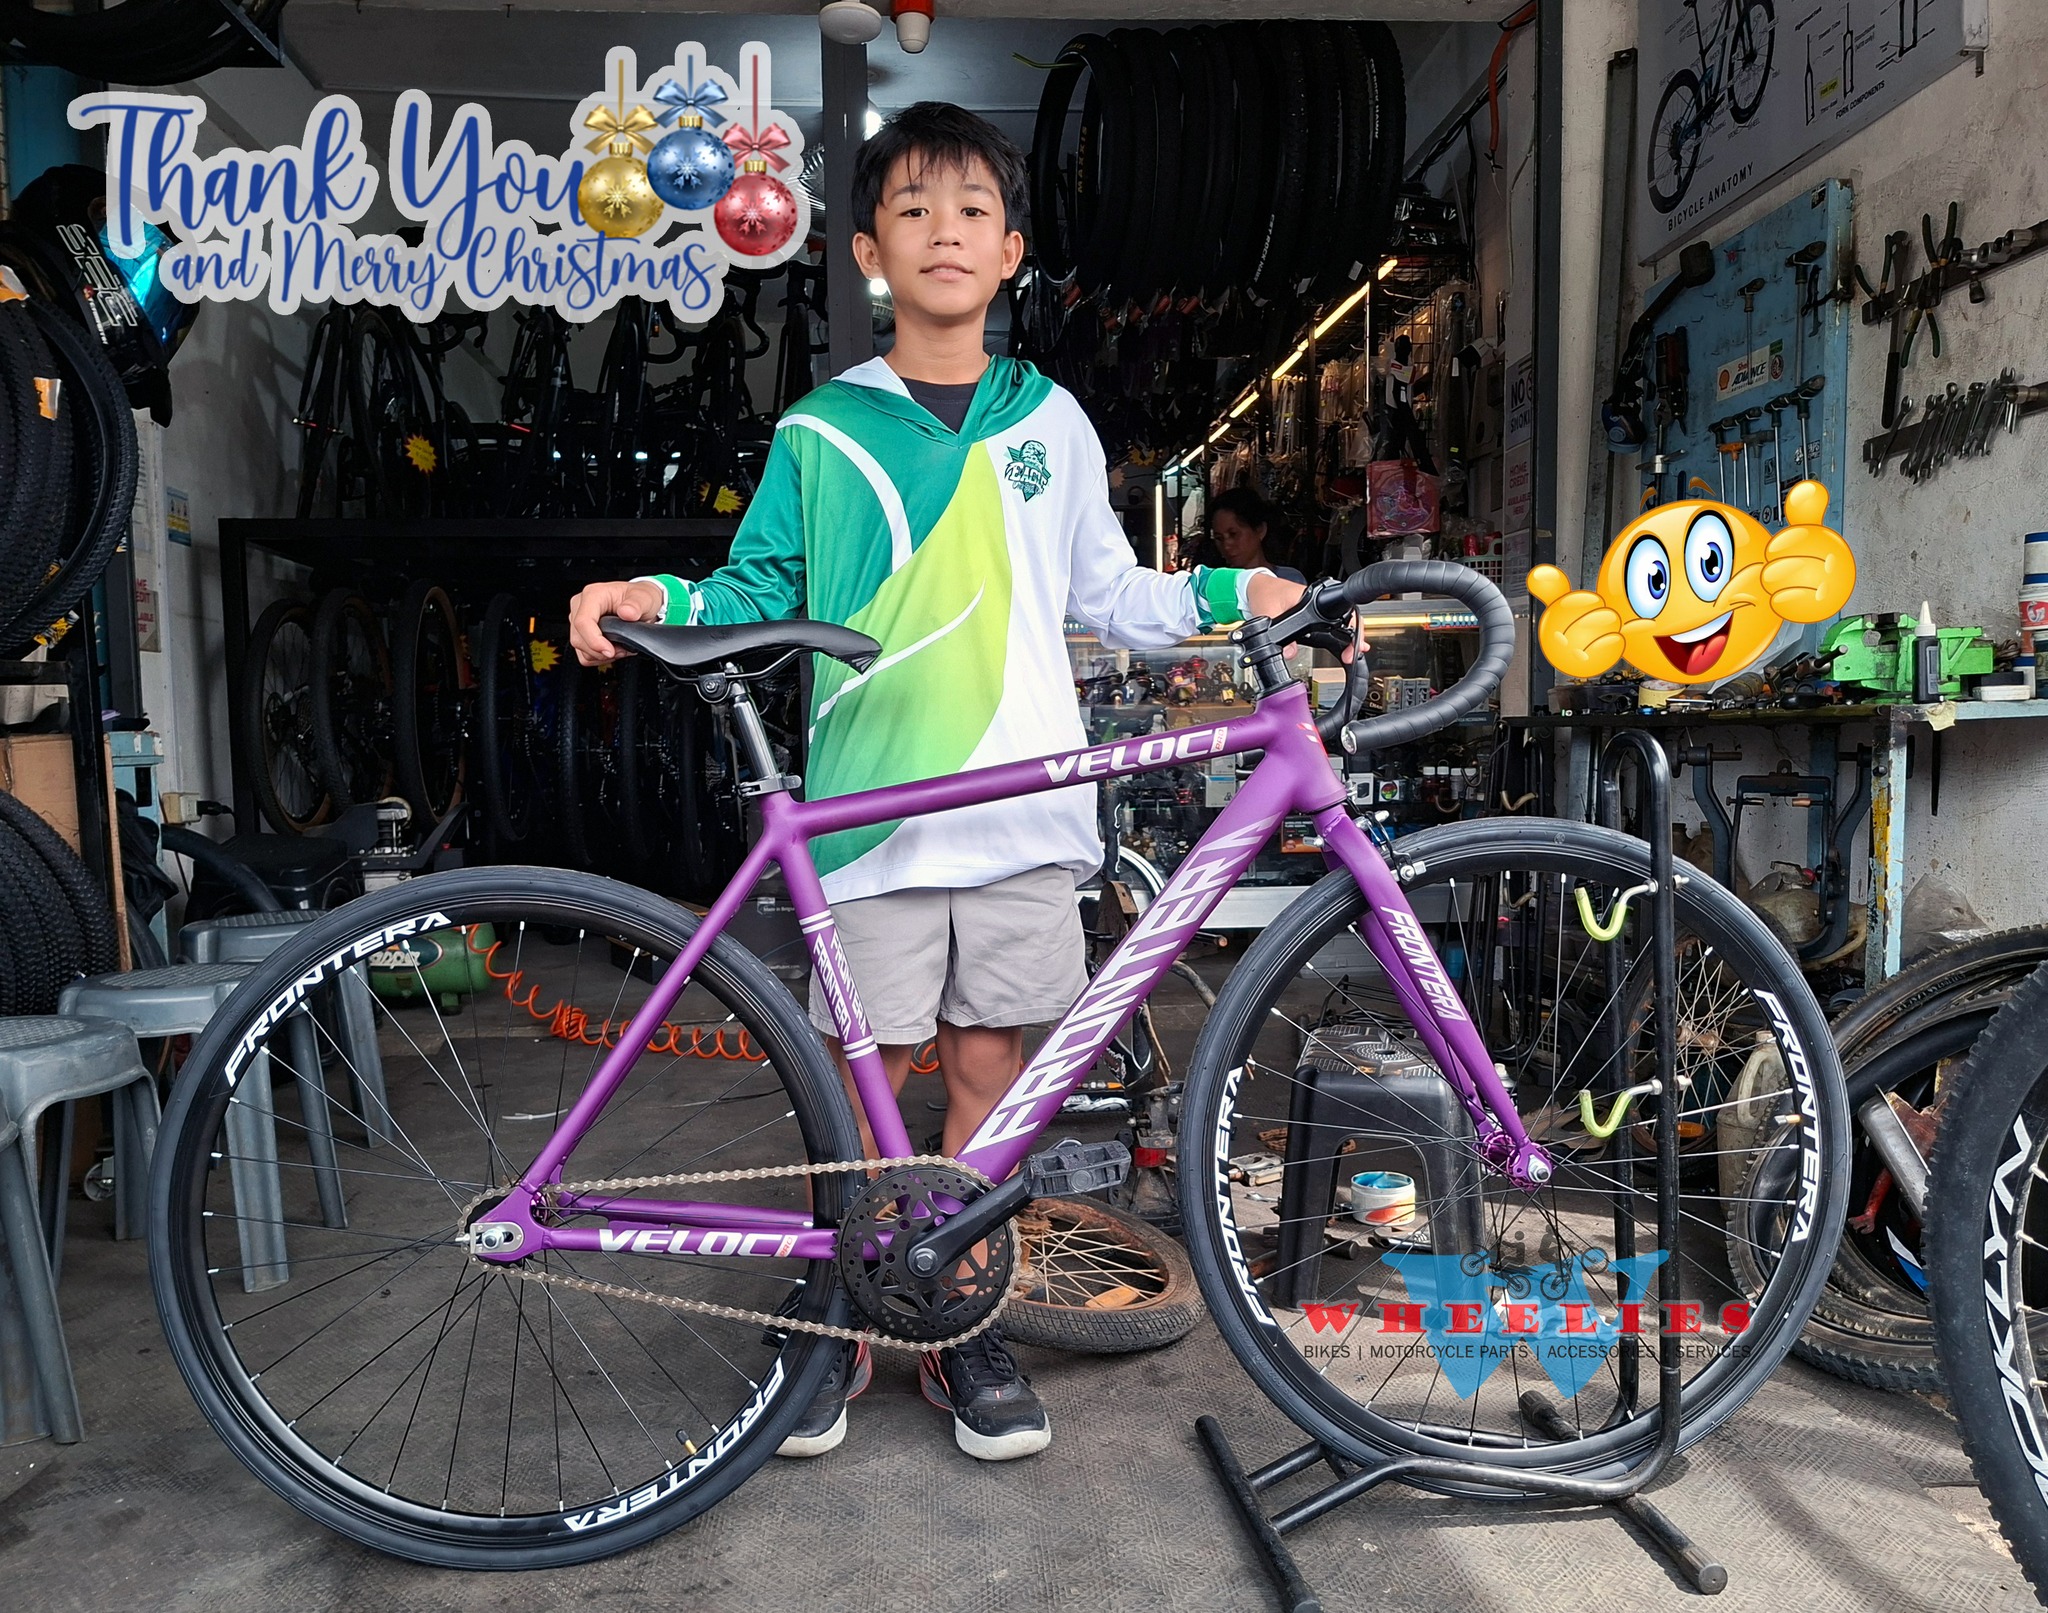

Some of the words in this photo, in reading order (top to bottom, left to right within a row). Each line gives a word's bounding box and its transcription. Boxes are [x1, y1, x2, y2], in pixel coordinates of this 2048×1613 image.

[1835, 102, 1849, 120] FORK
[1849, 80, 1885, 110] COMPONENTS
[1077, 125, 1089, 194] MAXXIS
[1668, 196, 1705, 232] BICYCLE
[1708, 161, 1755, 204] ANATOMY
[1510, 411, 1531, 433] SMOKI
[1511, 379, 1525, 408] NO
[1509, 461, 1527, 476] HOME
[1509, 473, 1529, 489] CREDIT
[135, 592, 151, 604] EDIT
[1043, 726, 1228, 783] VELOCI
[224, 911, 452, 1087] FRONTERA
[813, 932, 852, 1043] FRONTERA
[830, 927, 867, 1037] FRONTERA
[962, 811, 1282, 1154] FRONTERA
[1380, 906, 1468, 1022] FRONTERA
[1753, 988, 1821, 1243] FRONTERA
[1215, 1066, 1278, 1327] FRONTERA
[599, 1229, 798, 1258] VELOCI
[1983, 1113, 2048, 1507] OKLYN
[563, 1357, 787, 1533] FRONTERA
